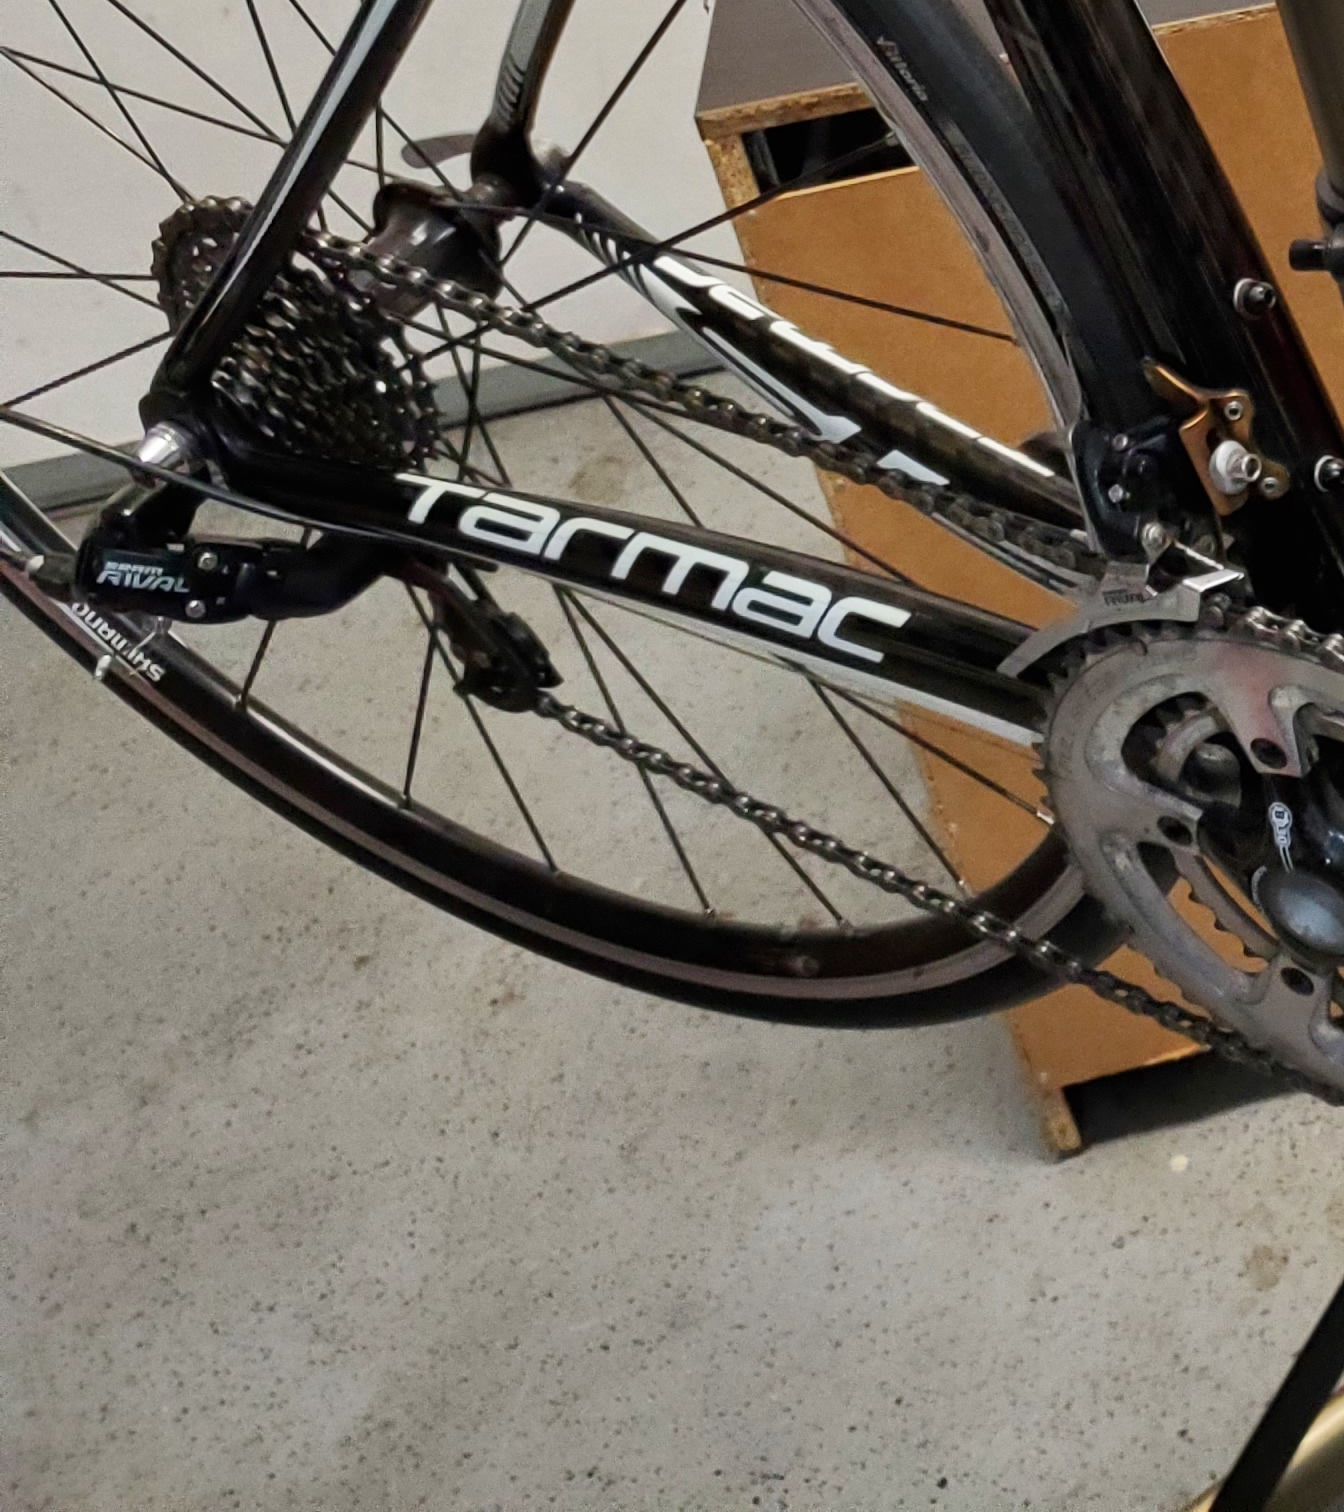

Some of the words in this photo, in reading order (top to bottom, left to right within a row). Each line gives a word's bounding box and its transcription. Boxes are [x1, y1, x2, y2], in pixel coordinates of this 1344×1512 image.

[96, 570, 190, 593] RIVAL
[393, 472, 911, 665] tarmac
[71, 601, 166, 683] SHIMANO
